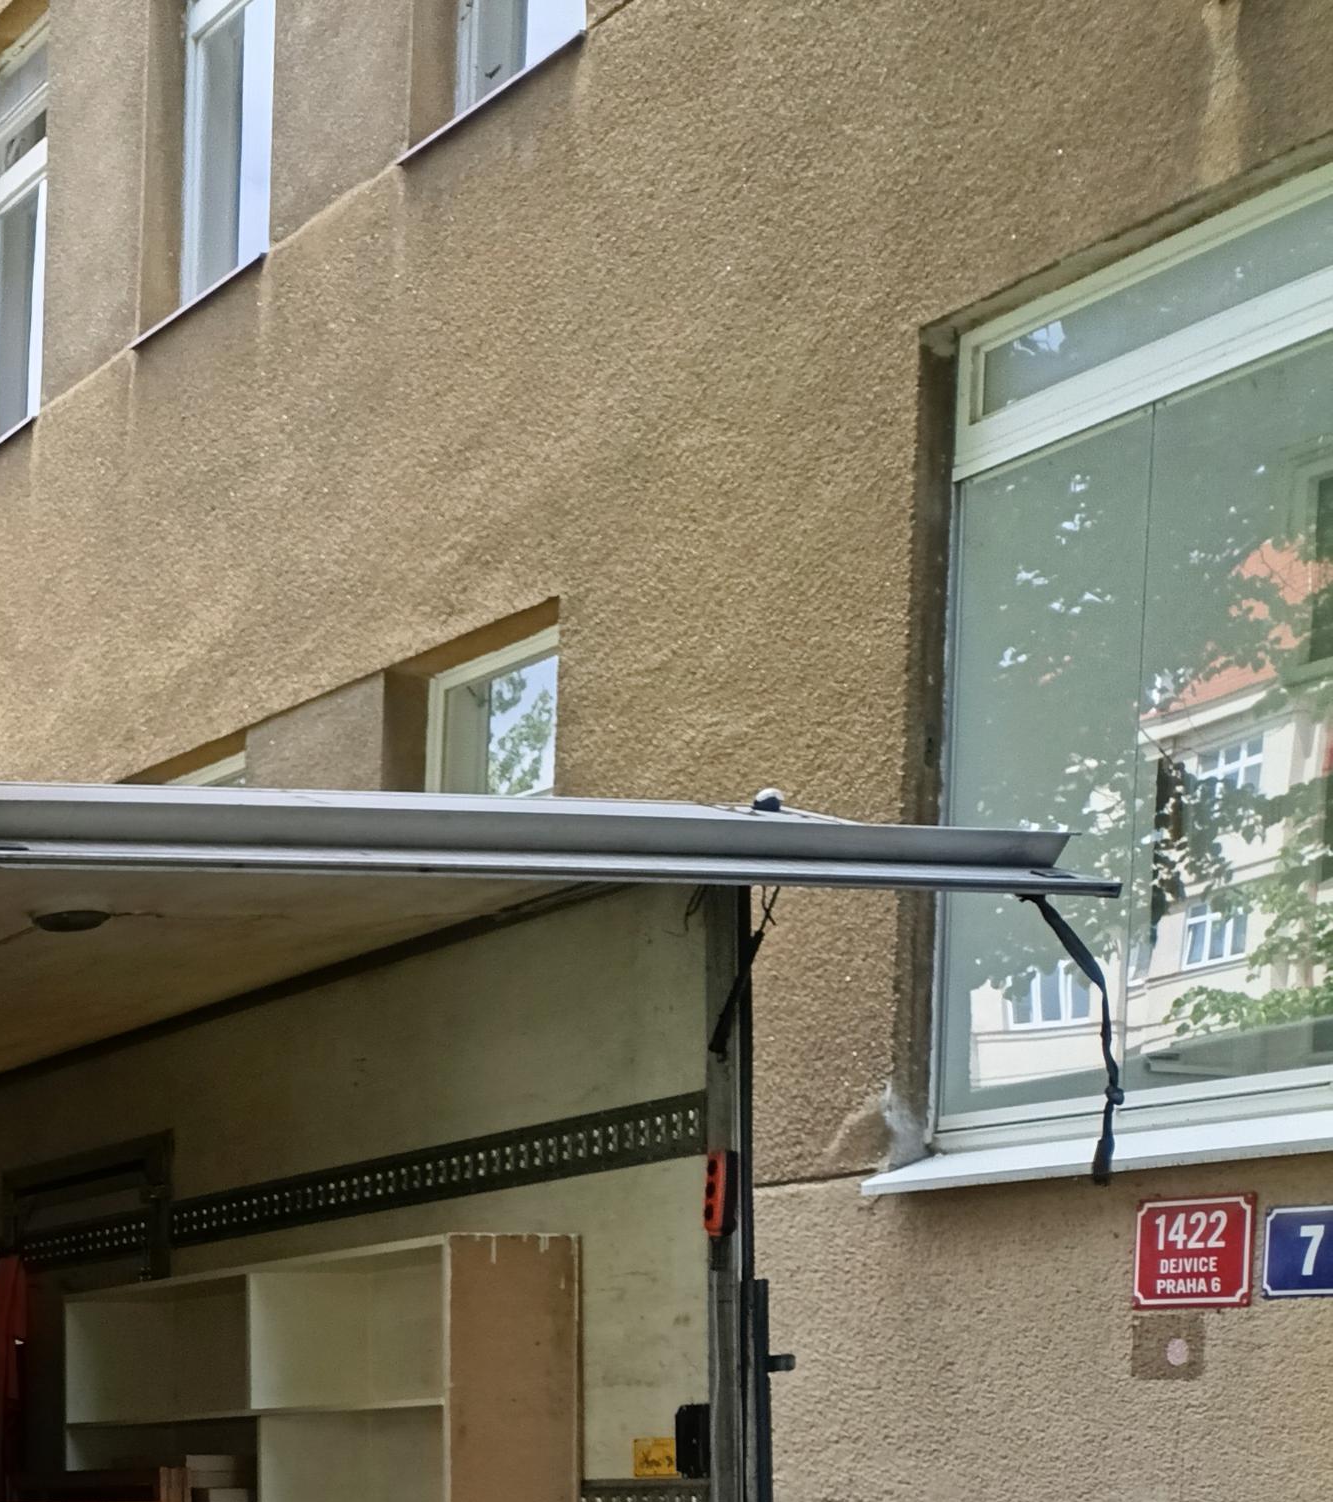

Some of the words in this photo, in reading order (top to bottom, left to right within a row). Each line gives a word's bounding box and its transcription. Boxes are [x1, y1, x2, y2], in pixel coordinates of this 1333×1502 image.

[1155, 1210, 1228, 1250] 1422
[1299, 1224, 1325, 1276] 7
[1159, 1256, 1218, 1274] DEJVICE
[1156, 1279, 1207, 1294] PRAHA
[1211, 1277, 1221, 1292] 6
